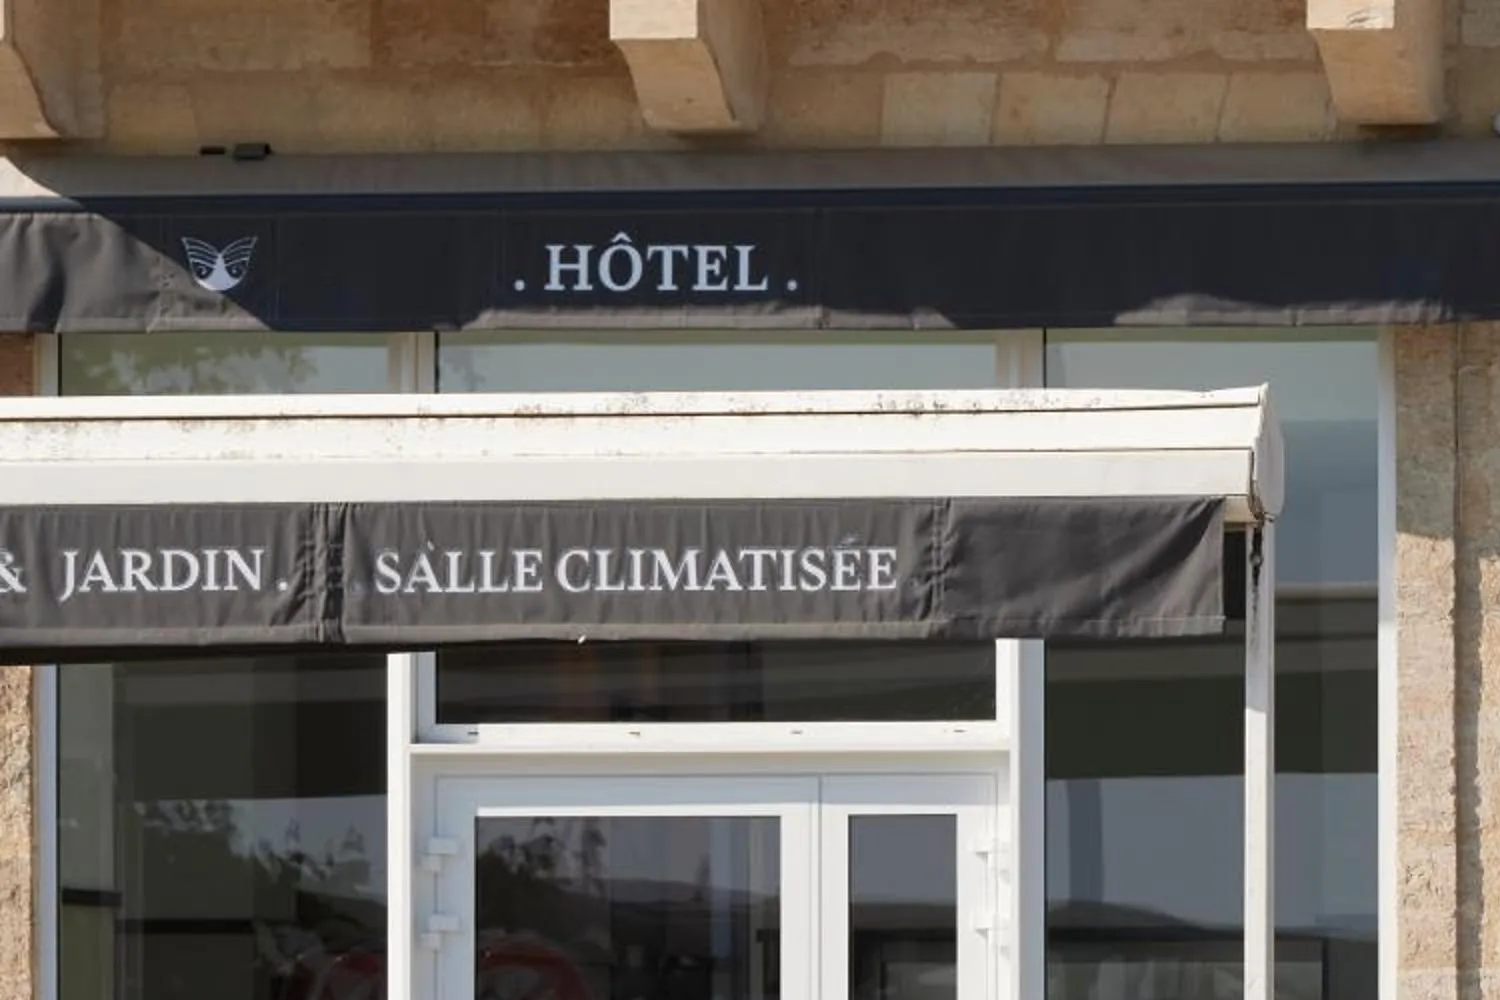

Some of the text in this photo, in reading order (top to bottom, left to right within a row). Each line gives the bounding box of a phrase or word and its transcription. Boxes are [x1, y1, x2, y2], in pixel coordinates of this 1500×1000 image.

[544, 232, 768, 291] HÔTEL
[0, 548, 265, 606] & JARDIN
[556, 537, 898, 593] CLIMATISÉE
